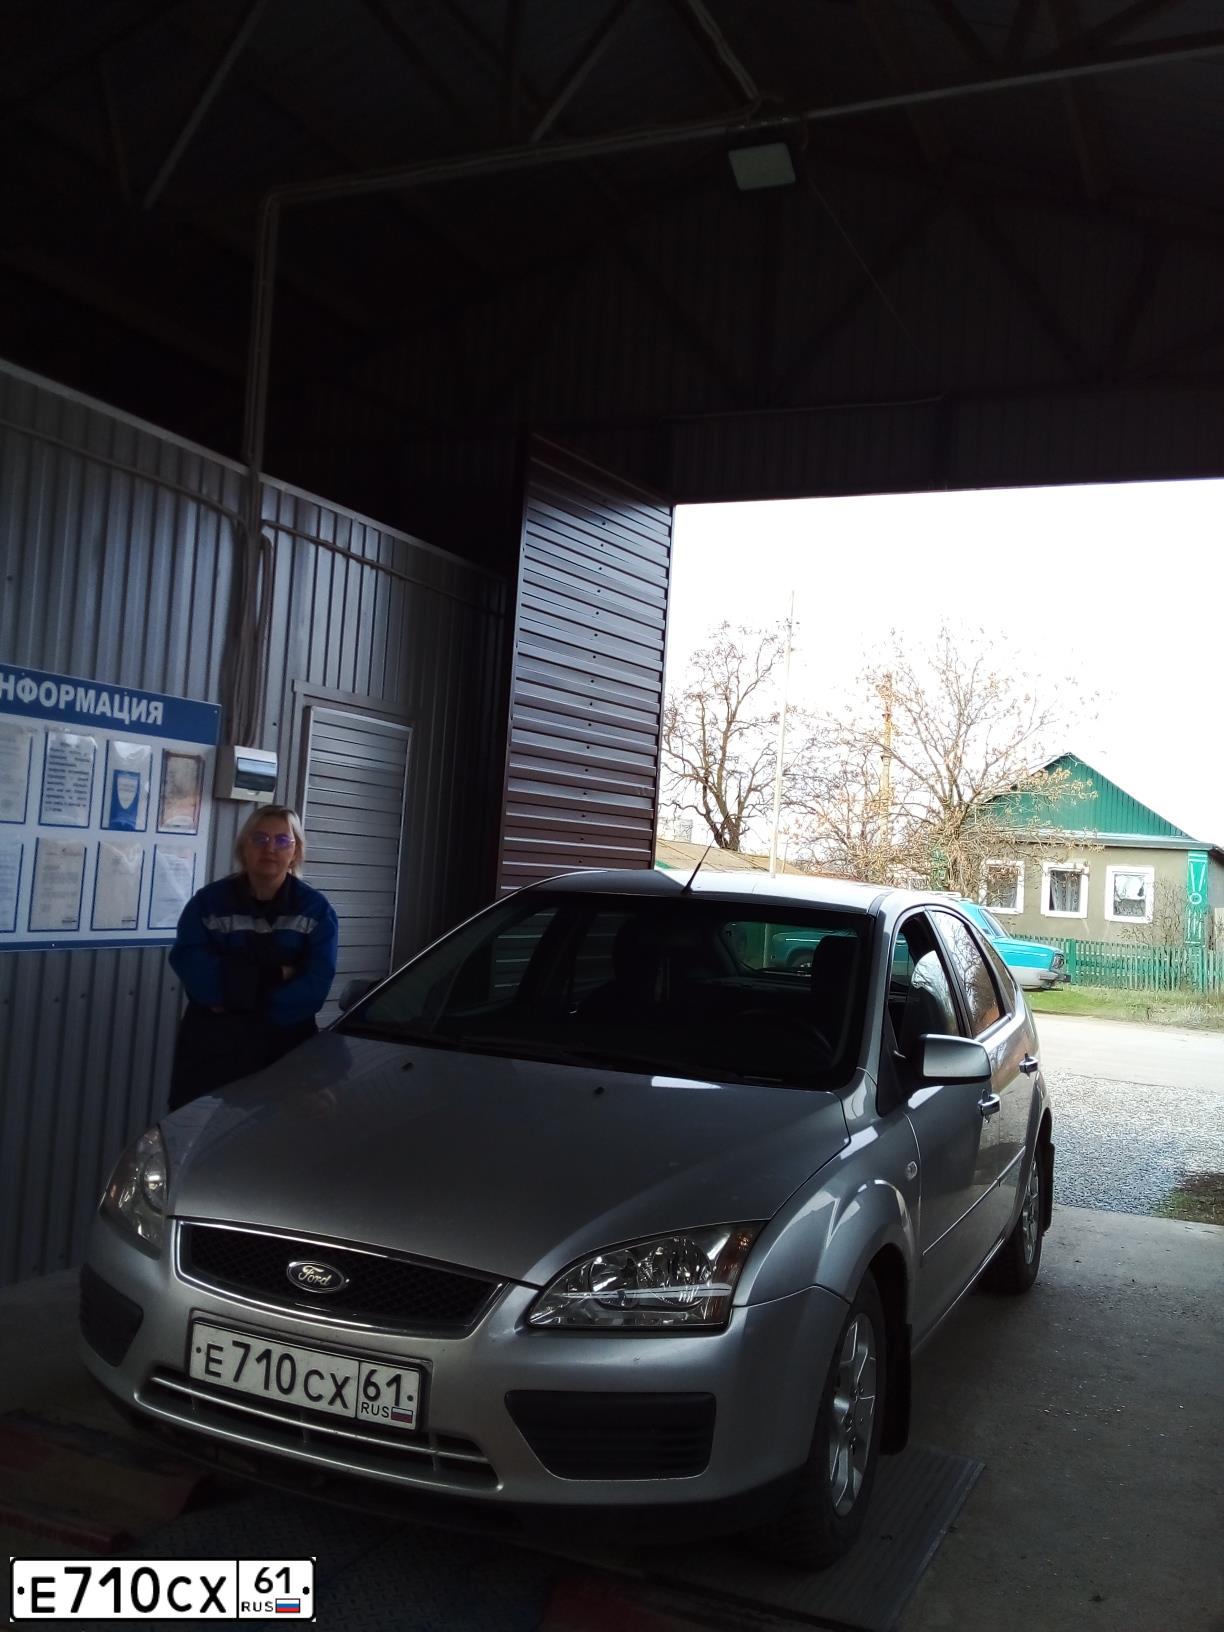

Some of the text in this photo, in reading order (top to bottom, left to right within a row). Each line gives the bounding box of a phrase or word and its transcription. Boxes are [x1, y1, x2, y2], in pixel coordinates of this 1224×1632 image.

[298, 1265, 332, 1286] Ford
[362, 1369, 402, 1407] 61
[361, 1401, 390, 1418] RUS
